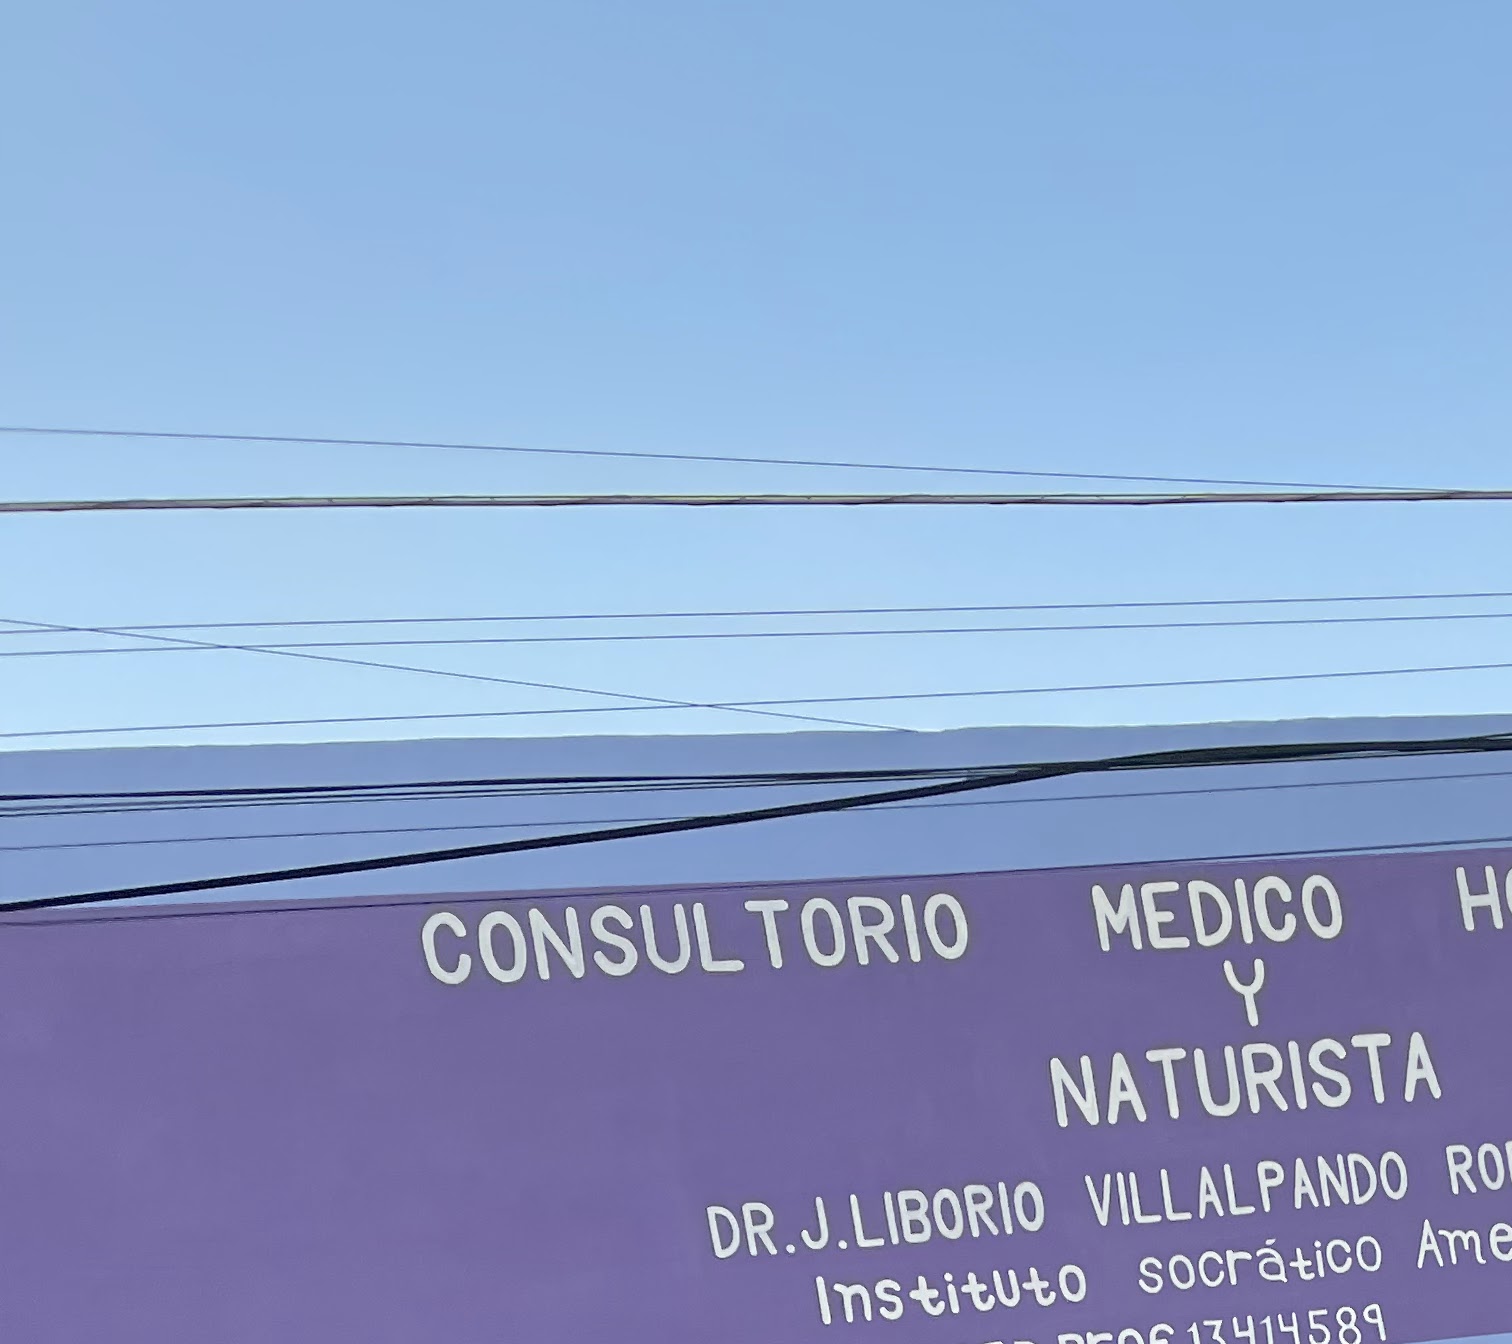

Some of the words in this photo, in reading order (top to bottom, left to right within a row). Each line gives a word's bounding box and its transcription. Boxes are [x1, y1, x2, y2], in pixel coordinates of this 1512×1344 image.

[421, 893, 969, 985] CONSULTORIO
[1091, 874, 1343, 952] MEDICO
[1223, 958, 1265, 1027] Y
[1050, 1031, 1442, 1128] NATURISTA
[1084, 1151, 1408, 1227] VILLALPANDO
[815, 1264, 1087, 1325] Instituto
